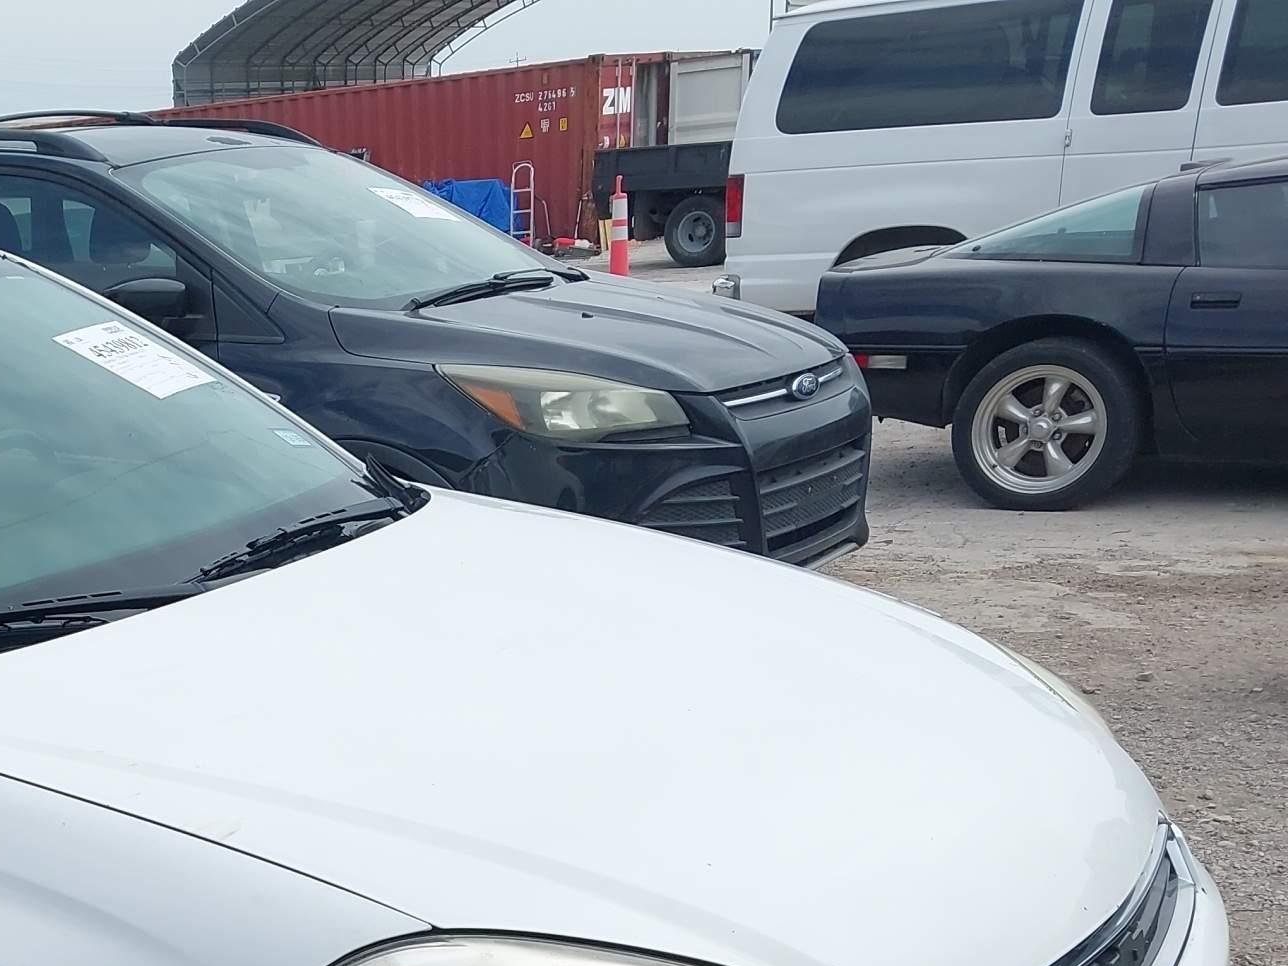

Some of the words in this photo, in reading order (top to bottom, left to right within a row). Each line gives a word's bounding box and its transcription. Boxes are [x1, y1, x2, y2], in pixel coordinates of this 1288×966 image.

[514, 92, 534, 104] ZCSU
[602, 86, 632, 115] ZIM
[538, 101, 556, 112] 42G1
